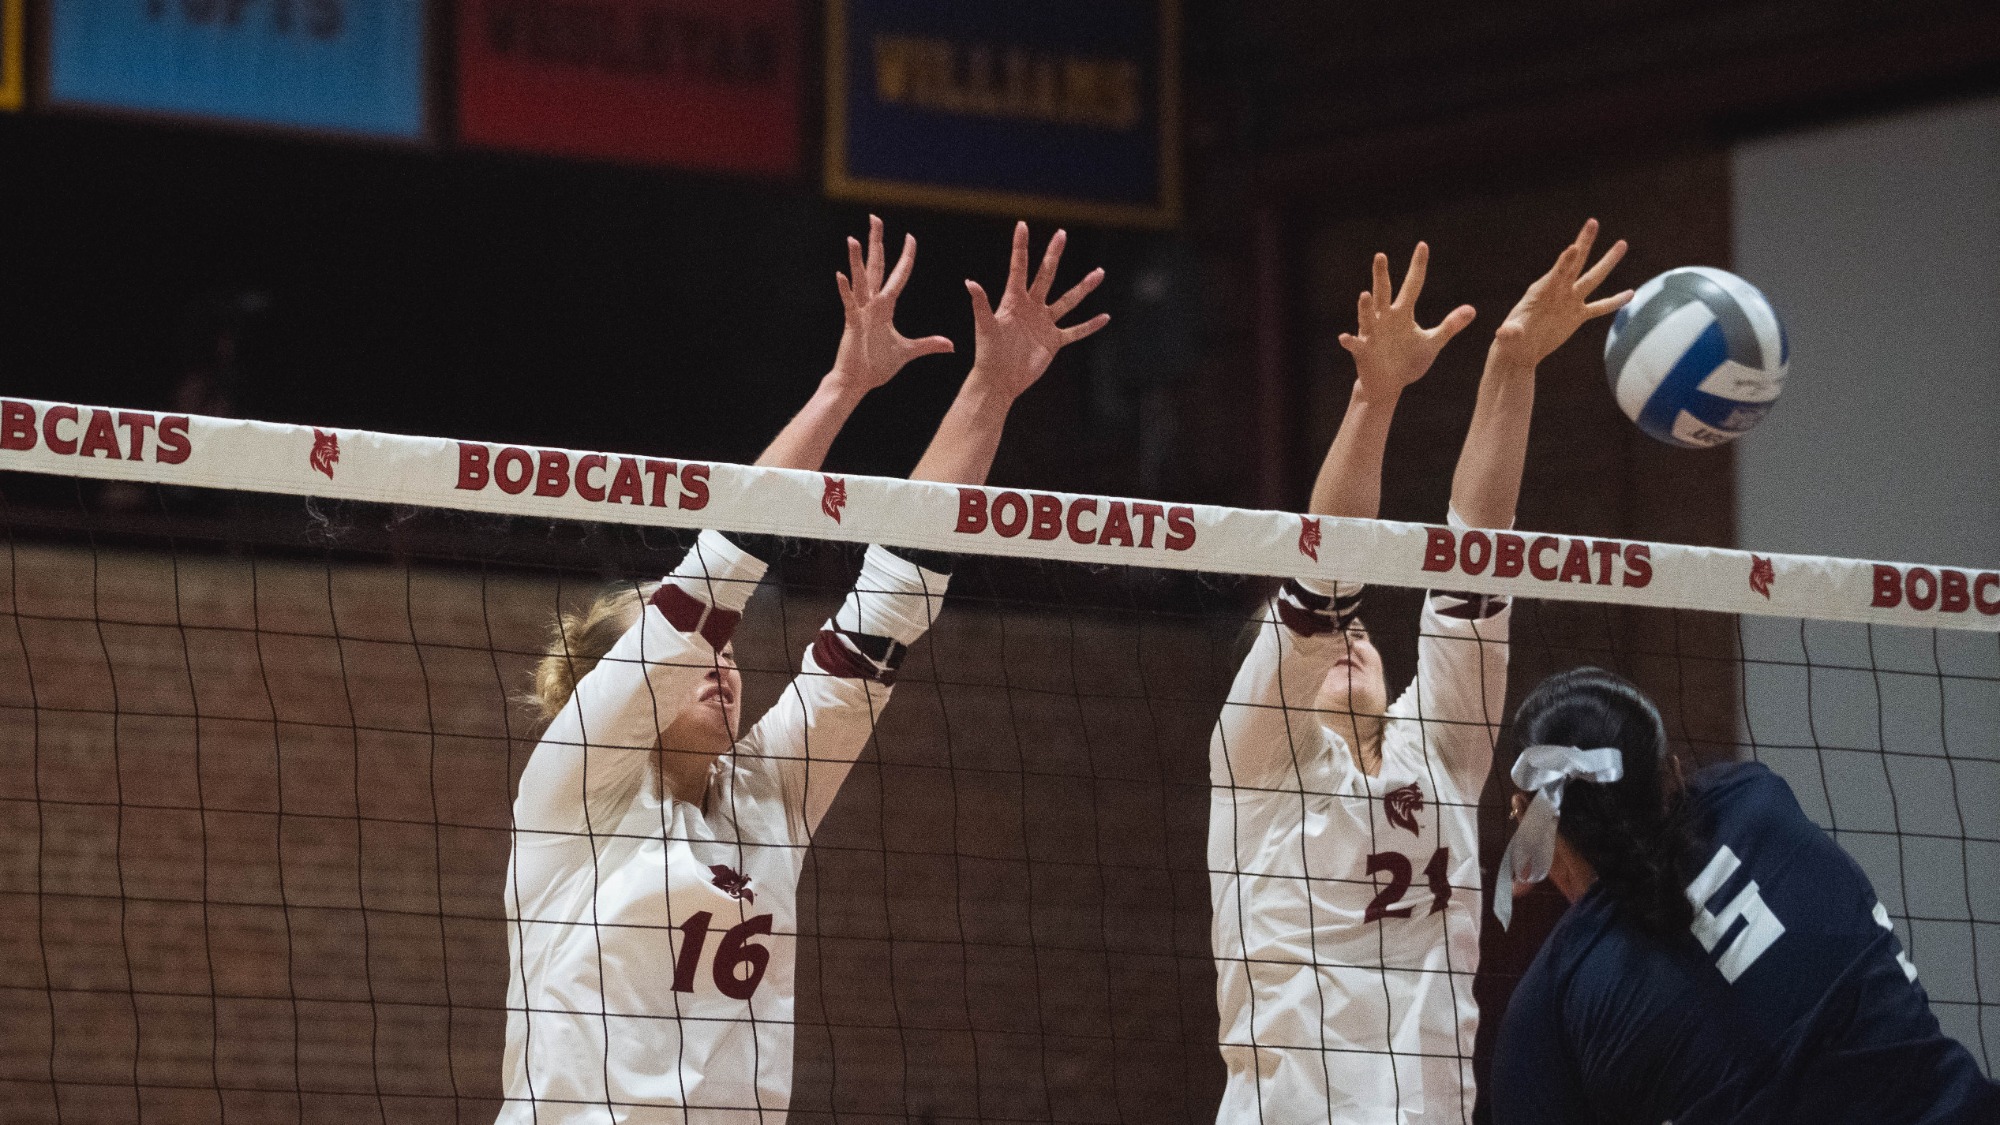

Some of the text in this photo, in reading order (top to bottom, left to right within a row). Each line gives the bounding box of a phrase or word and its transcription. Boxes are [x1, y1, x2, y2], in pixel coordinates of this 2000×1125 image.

[873, 36, 1140, 128] WILLIAMS
[0, 400, 2000, 616] BCATS BOBCATS BOBCATS BOBCATS BOBC
[1363, 847, 1452, 924] 21
[670, 911, 773, 1000] 16
